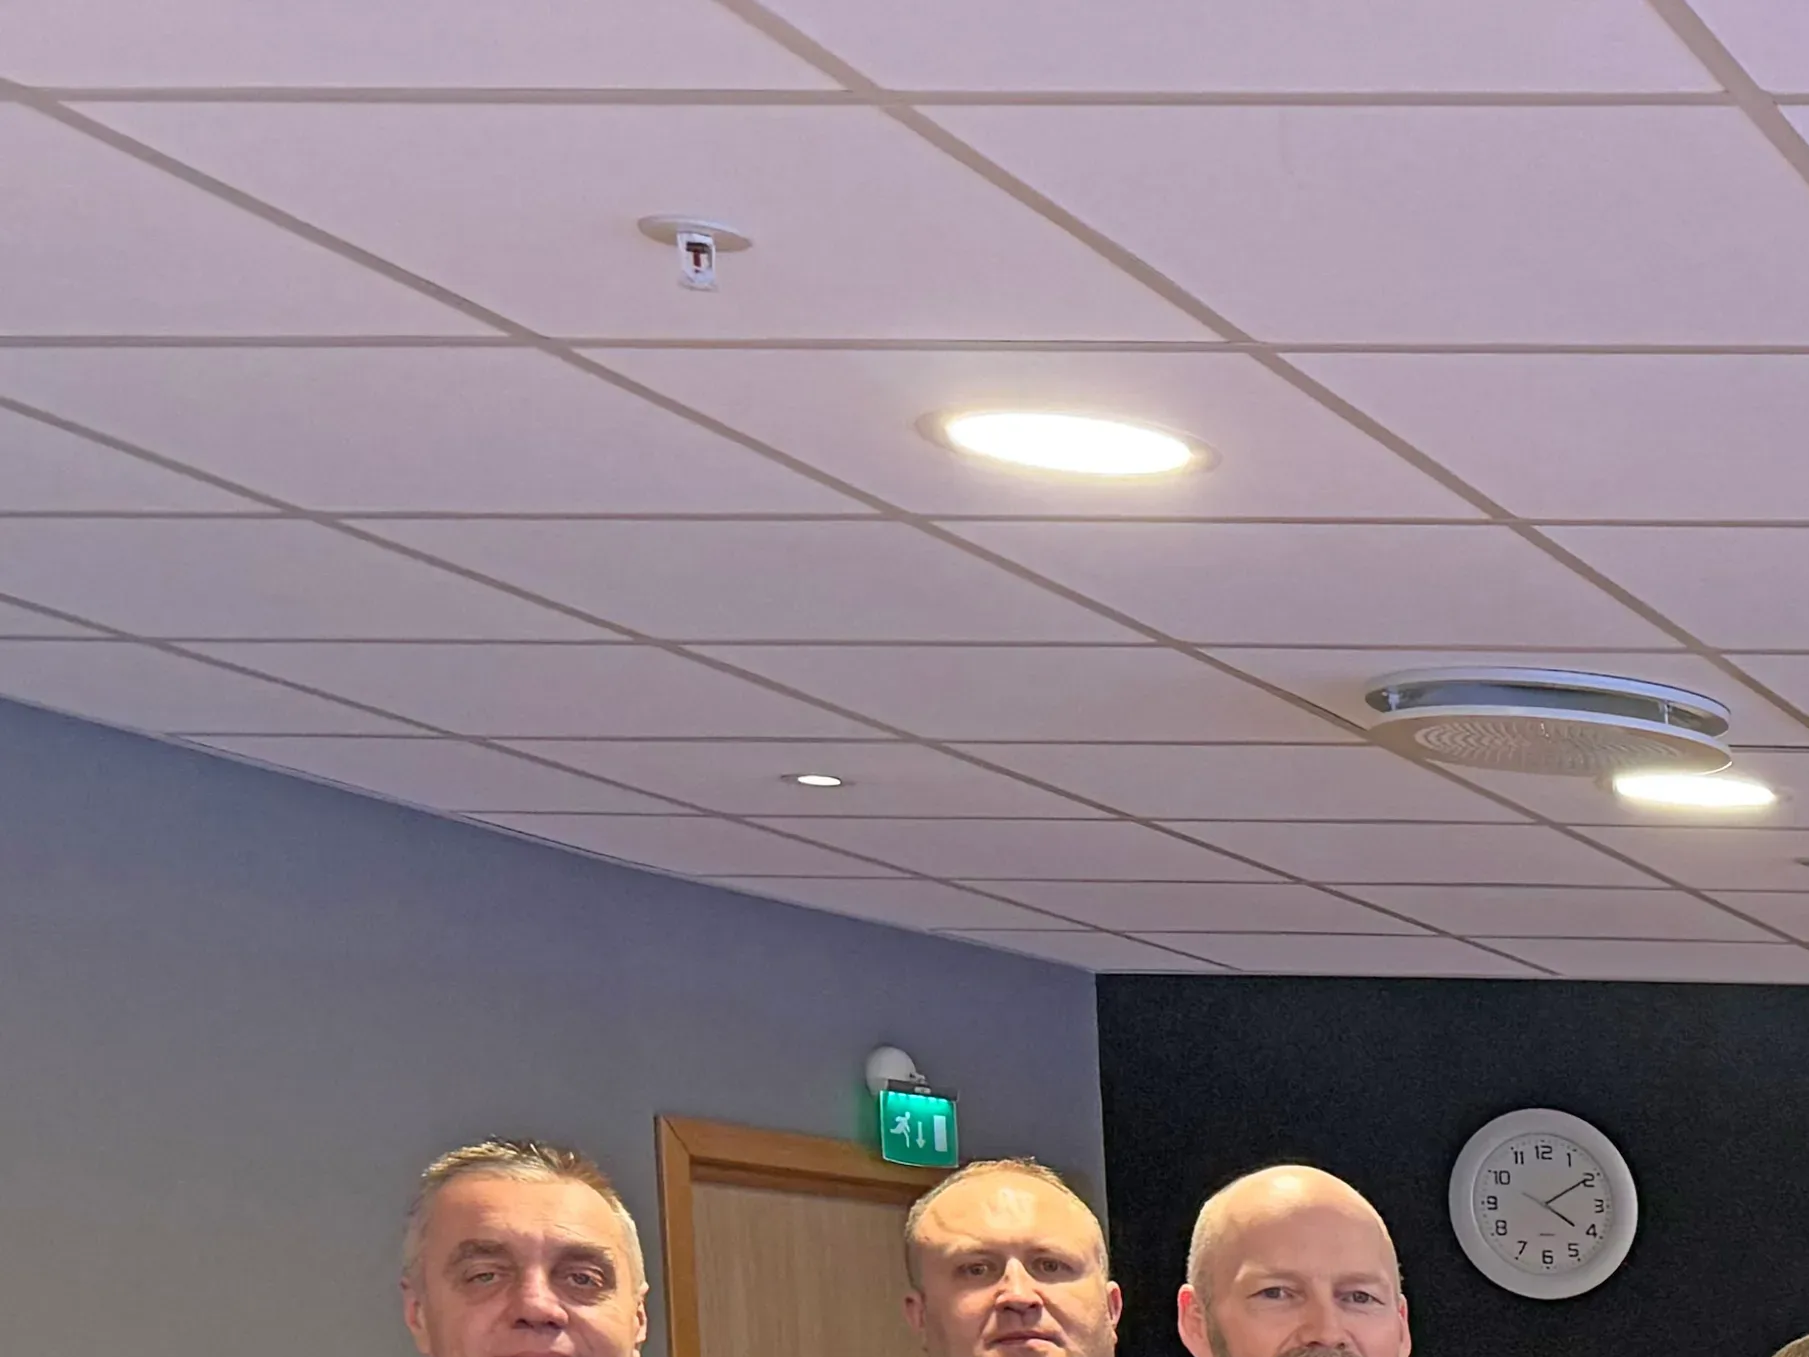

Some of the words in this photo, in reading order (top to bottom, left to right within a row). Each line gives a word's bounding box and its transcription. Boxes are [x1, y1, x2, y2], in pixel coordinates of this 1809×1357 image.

[1513, 1151, 1524, 1165] 11
[1535, 1145, 1553, 1160] 12
[1566, 1152, 1572, 1168] 1
[1493, 1170, 1511, 1185] 10
[1582, 1172, 1595, 1187] 2
[1486, 1196, 1498, 1210] 9
[1594, 1199, 1604, 1213] 3
[1495, 1220, 1507, 1236] 8
[1585, 1224, 1598, 1238] 4
[1517, 1241, 1528, 1255] 7
[1568, 1243, 1580, 1258] 5
[1542, 1250, 1554, 1265] 6
